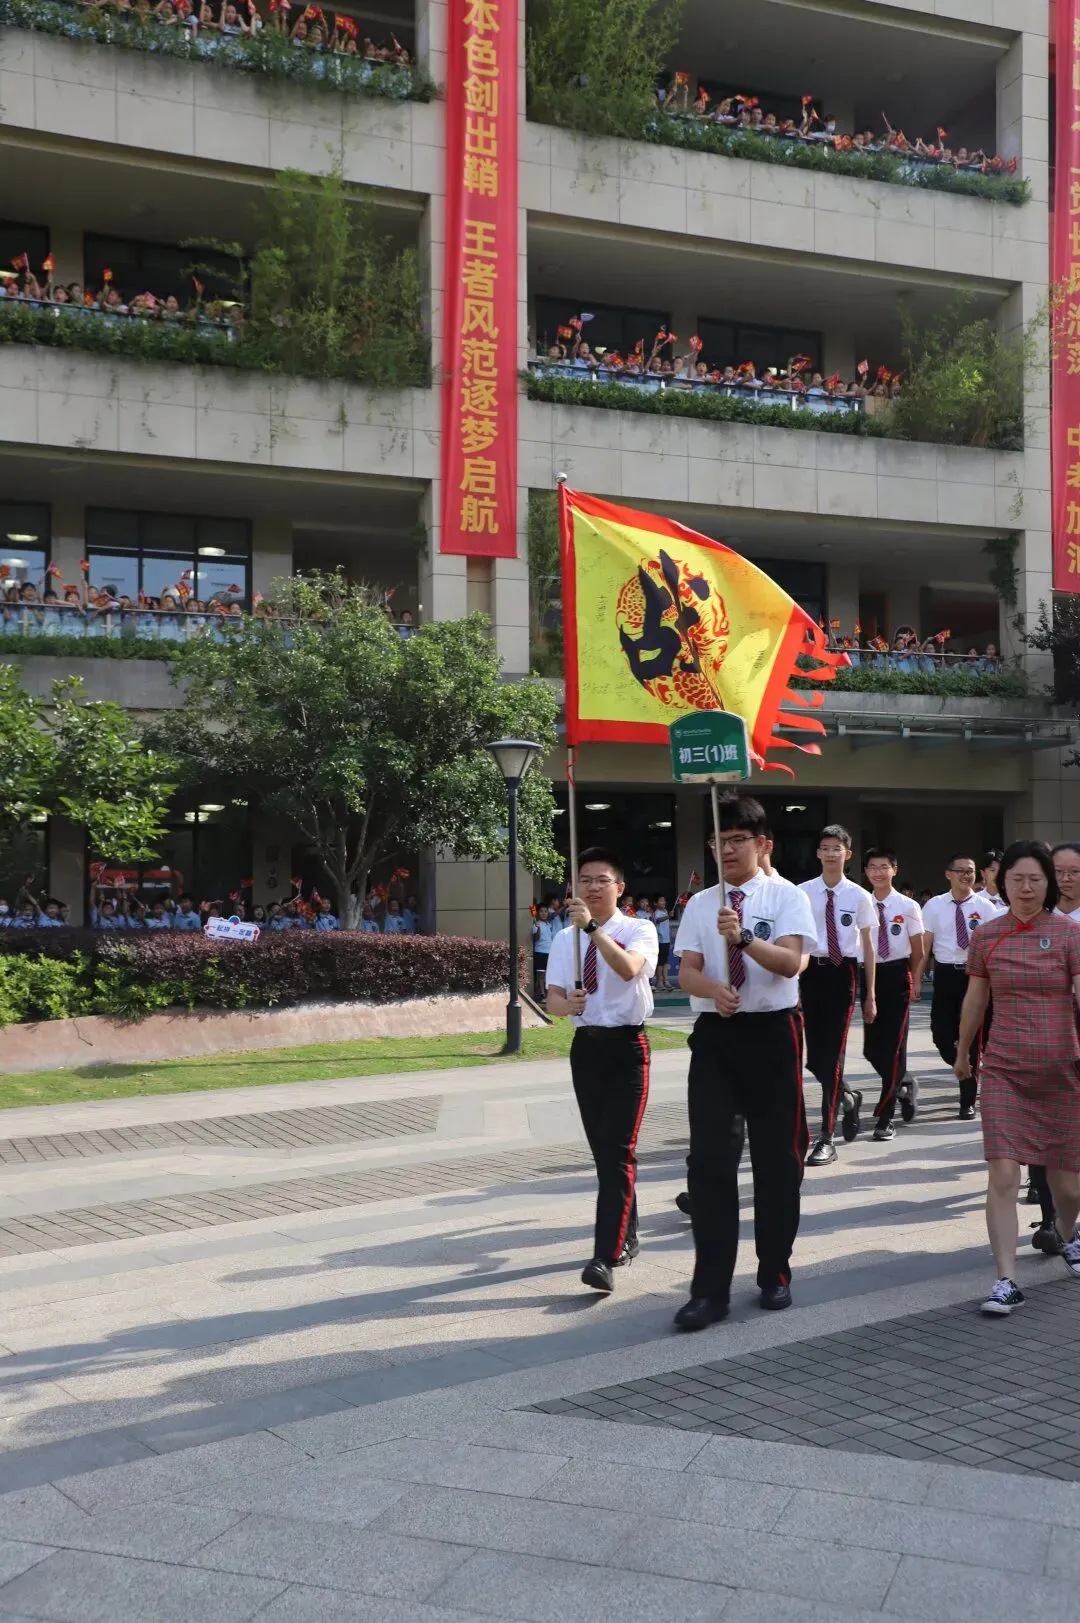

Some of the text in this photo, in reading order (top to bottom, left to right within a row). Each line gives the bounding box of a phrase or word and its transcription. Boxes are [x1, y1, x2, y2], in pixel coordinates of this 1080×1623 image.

[459, 0, 500, 534] 本色剑出鞘 王者风范逐梦启航
[679, 744, 738, 763] 初三(1)班
